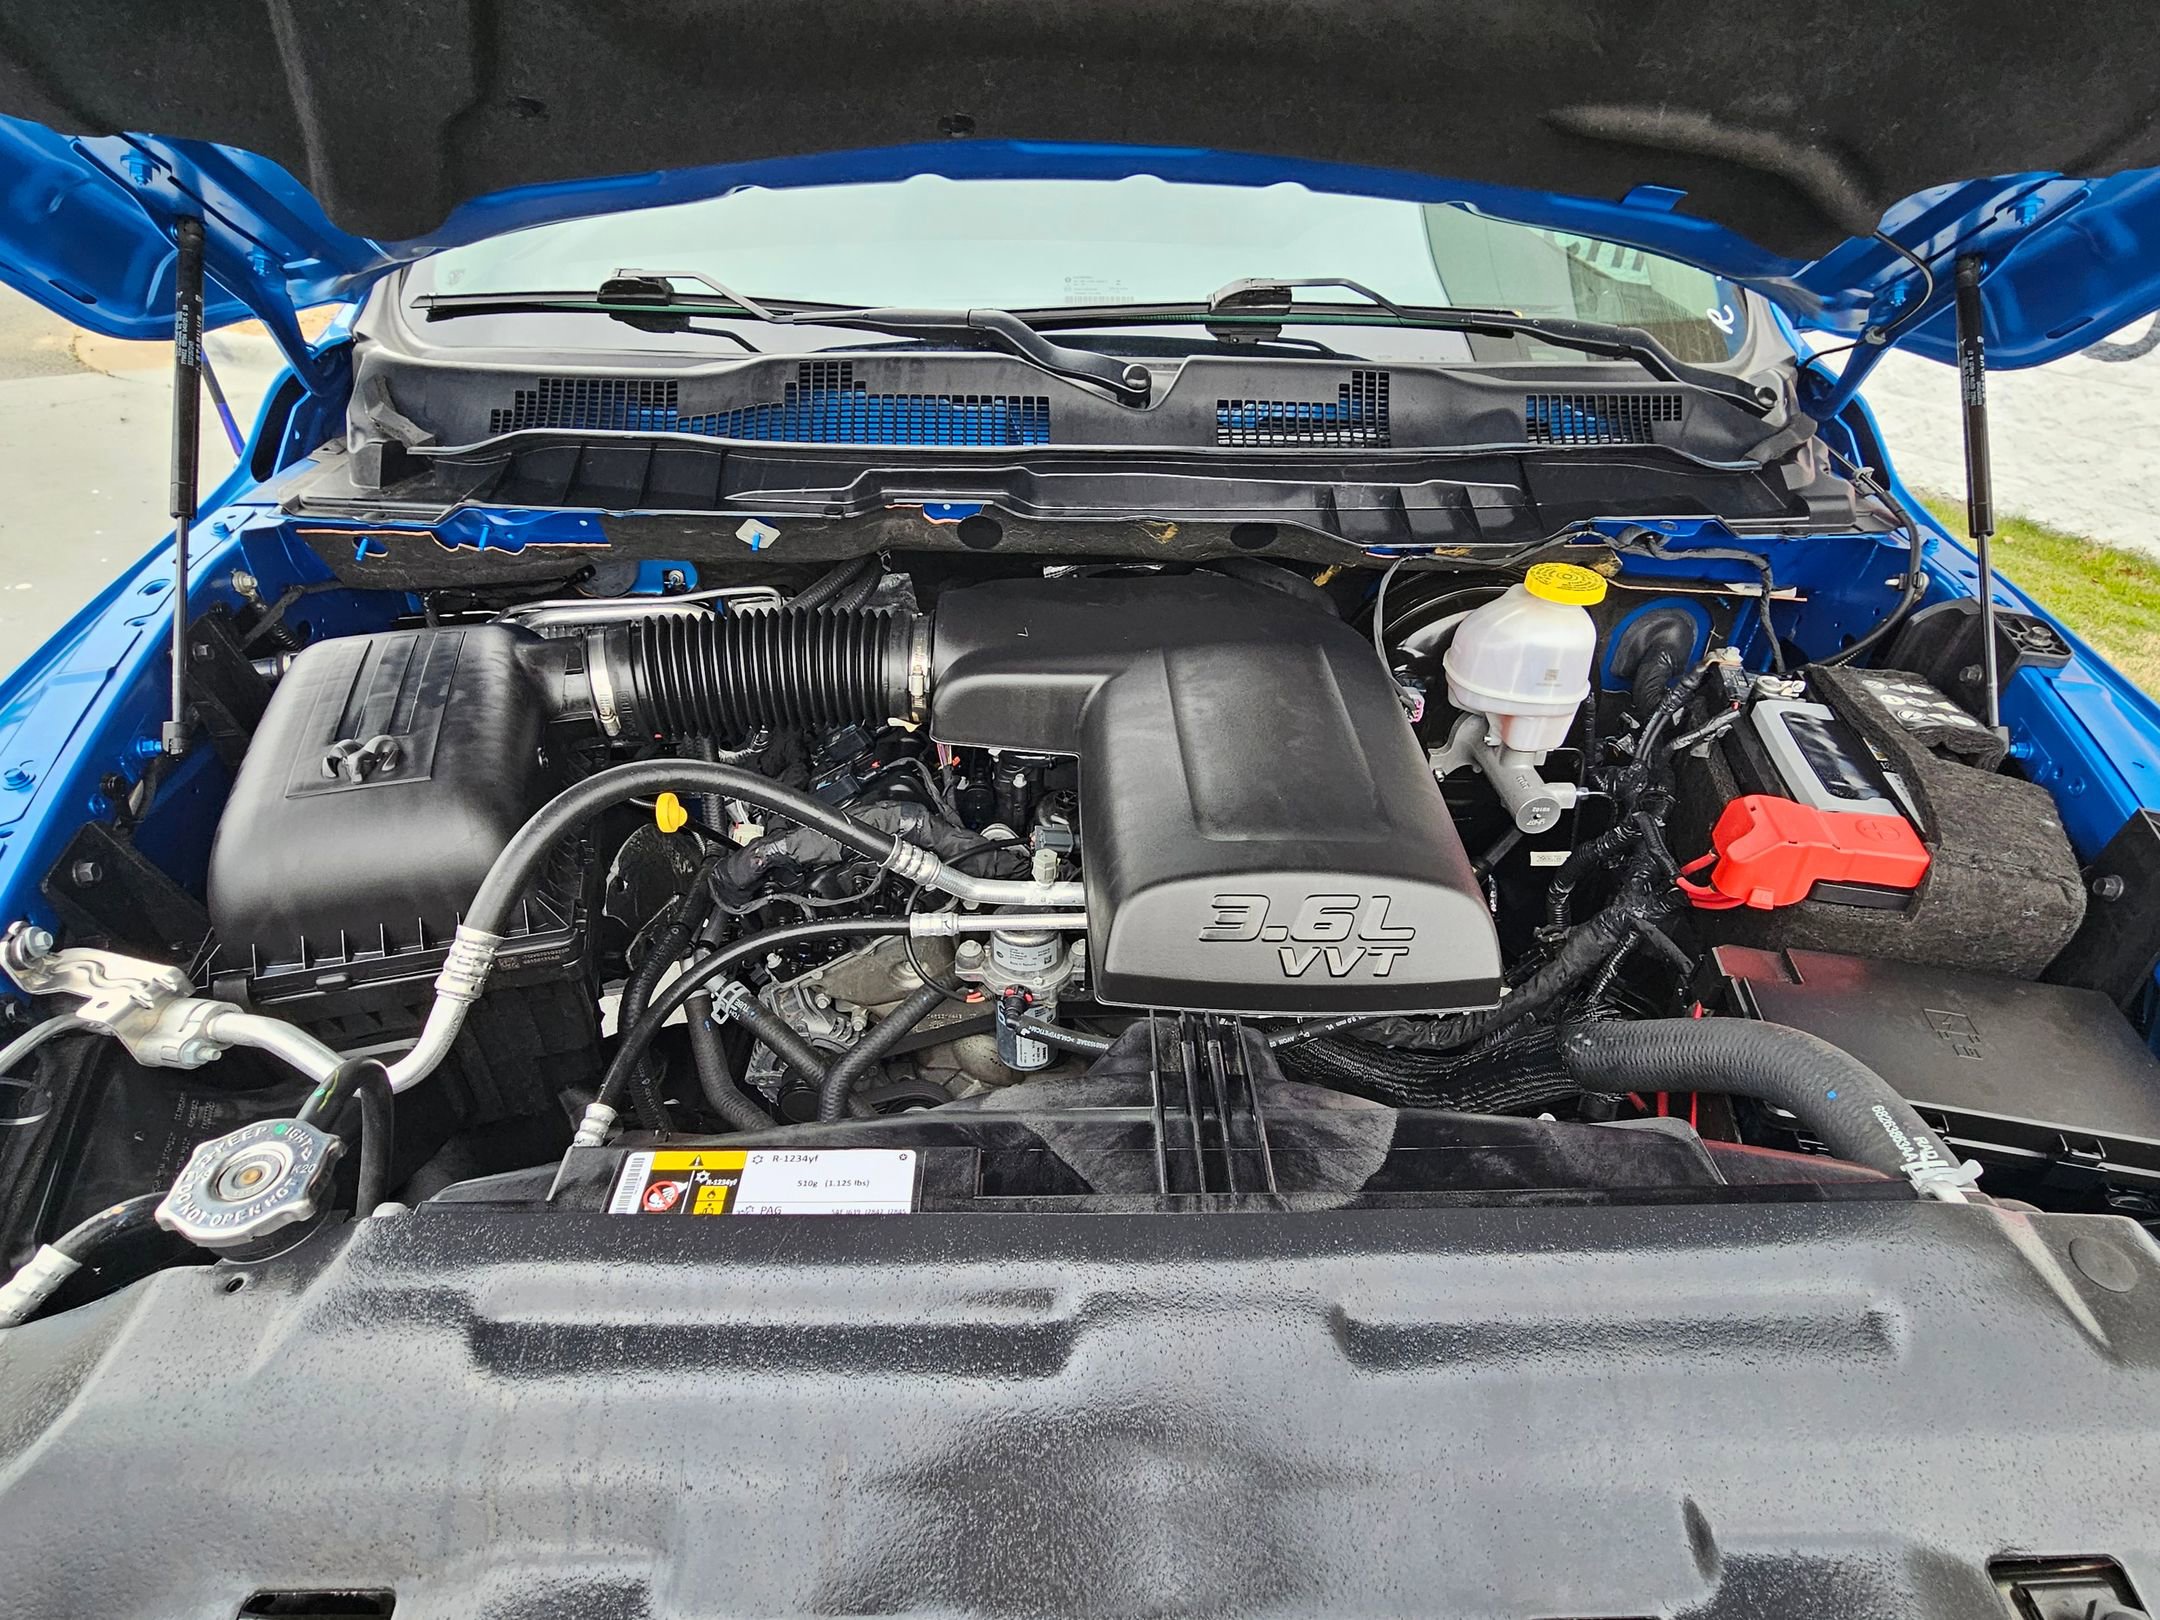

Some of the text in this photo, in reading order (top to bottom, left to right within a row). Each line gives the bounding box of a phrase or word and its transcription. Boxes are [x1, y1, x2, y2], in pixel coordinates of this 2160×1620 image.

[1199, 894, 1416, 942] 3.6L
[1277, 946, 1410, 978] VVT
[213, 1126, 268, 1154] KEEP
[273, 1123, 314, 1148] IGHT
[1912, 1135, 1939, 1161] RAD
[772, 1154, 819, 1164] R-1234yf
[796, 1179, 870, 1188] 510g (1.125 lbs)
[181, 1202, 209, 1225] NOT
[208, 1202, 263, 1228] OPEN
[760, 1205, 783, 1214] PAG
